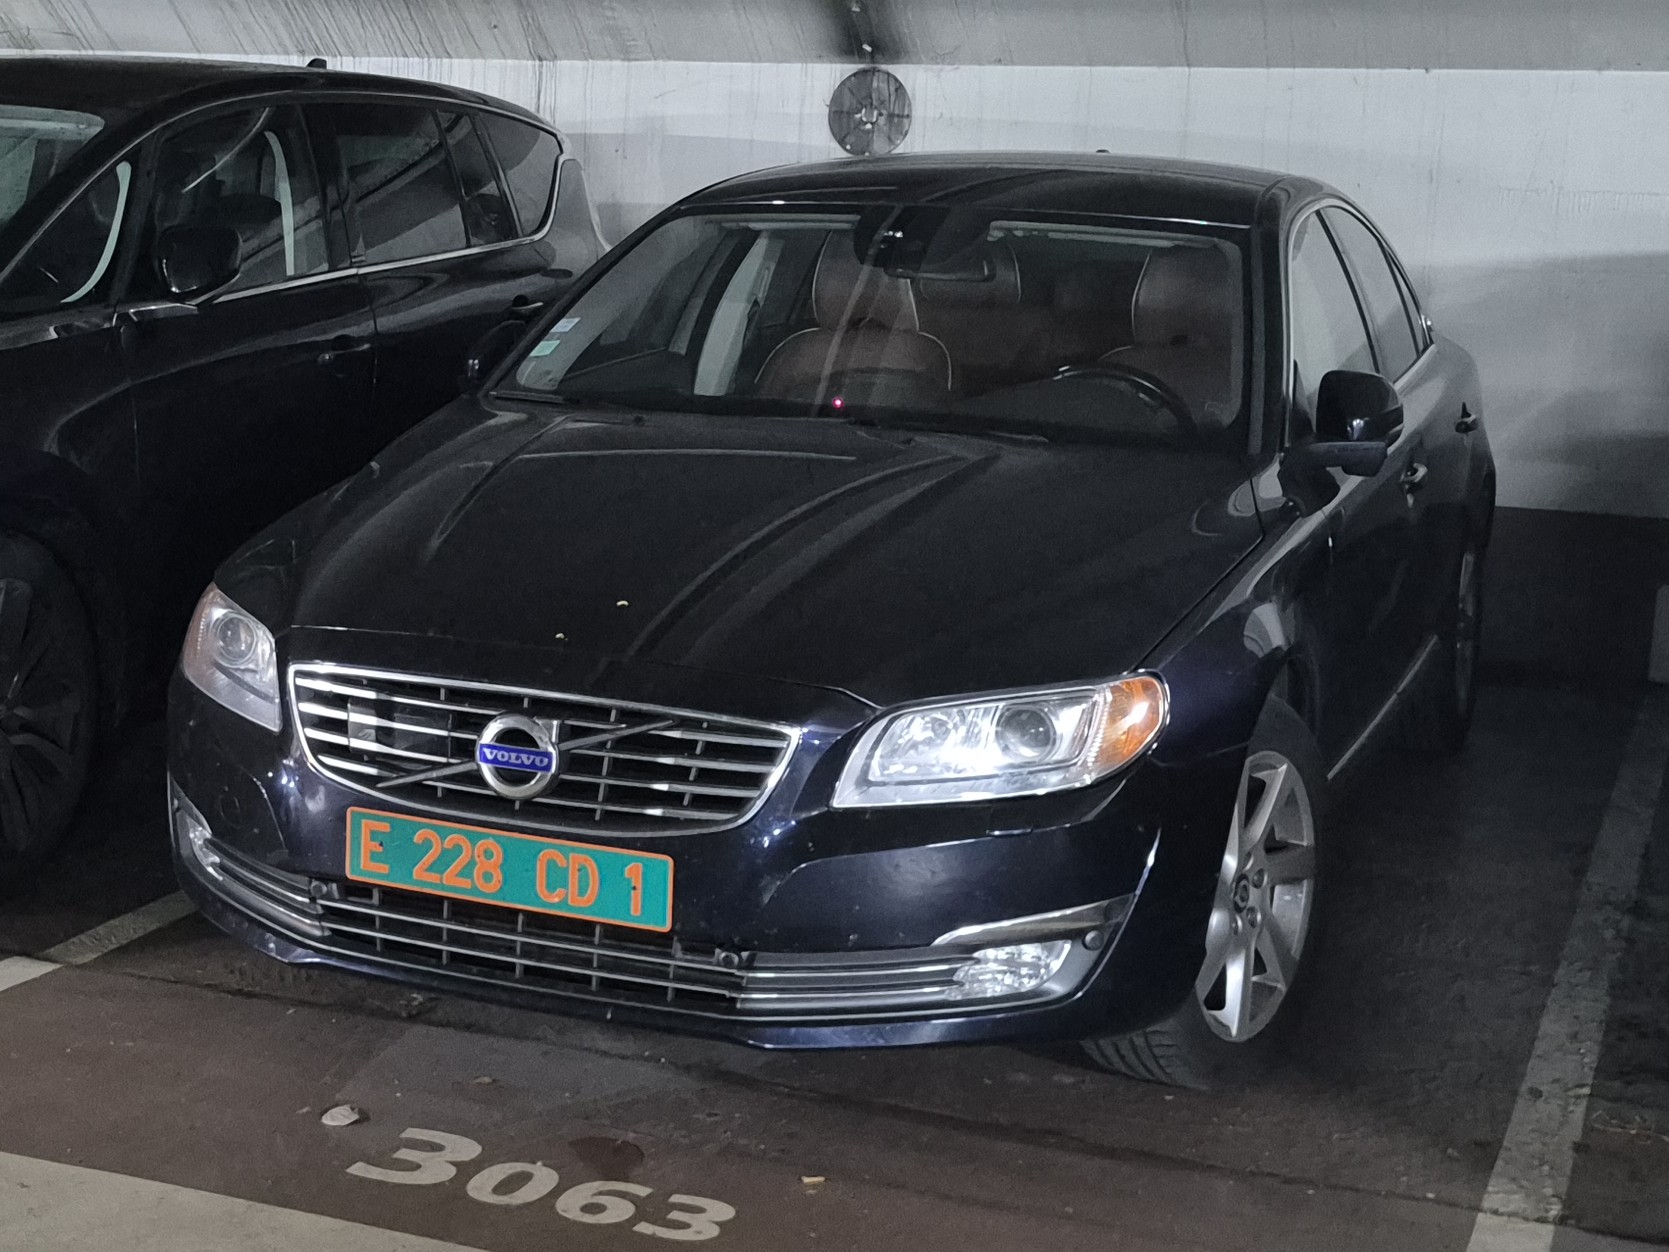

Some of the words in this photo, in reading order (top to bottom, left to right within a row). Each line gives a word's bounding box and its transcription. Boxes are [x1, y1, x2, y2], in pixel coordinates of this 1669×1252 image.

[482, 747, 549, 767] VOLVO
[360, 818, 391, 874] E
[413, 829, 503, 893] 228
[536, 849, 599, 907] CD
[624, 862, 643, 916] 1
[345, 1127, 736, 1241] 3063
